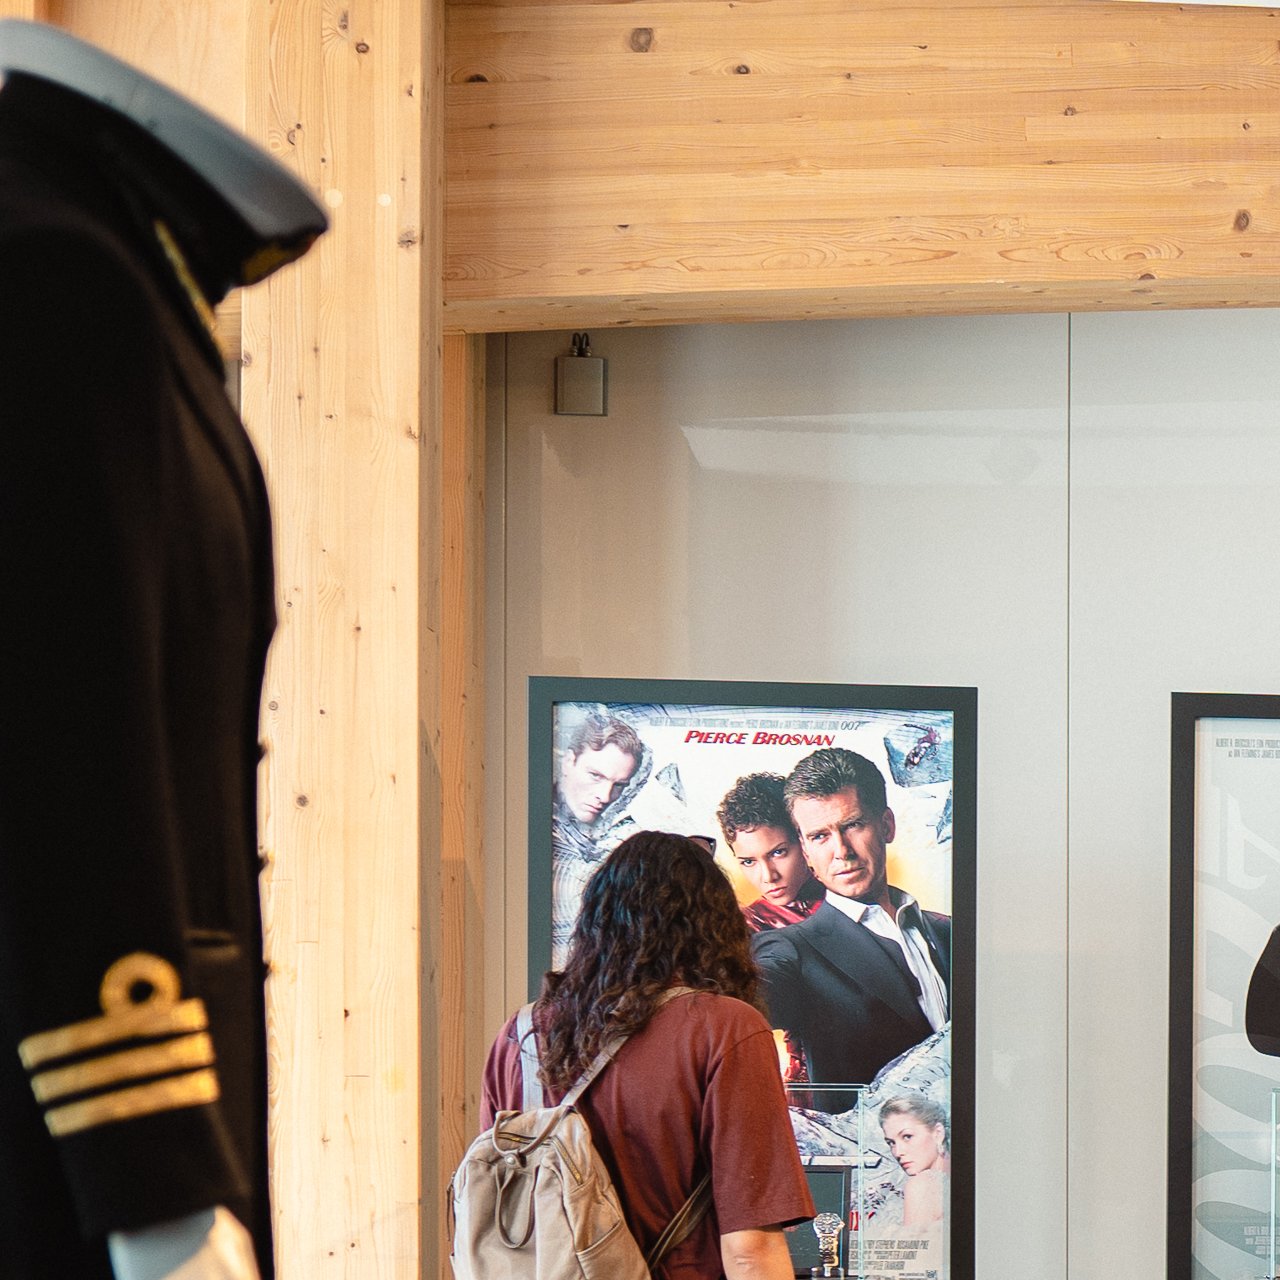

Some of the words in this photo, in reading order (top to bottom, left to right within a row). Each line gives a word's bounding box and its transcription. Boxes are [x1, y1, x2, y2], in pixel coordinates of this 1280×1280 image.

[840, 720, 865, 731] 007
[684, 730, 749, 744] PIERCE
[752, 731, 836, 746] BROSNAN
